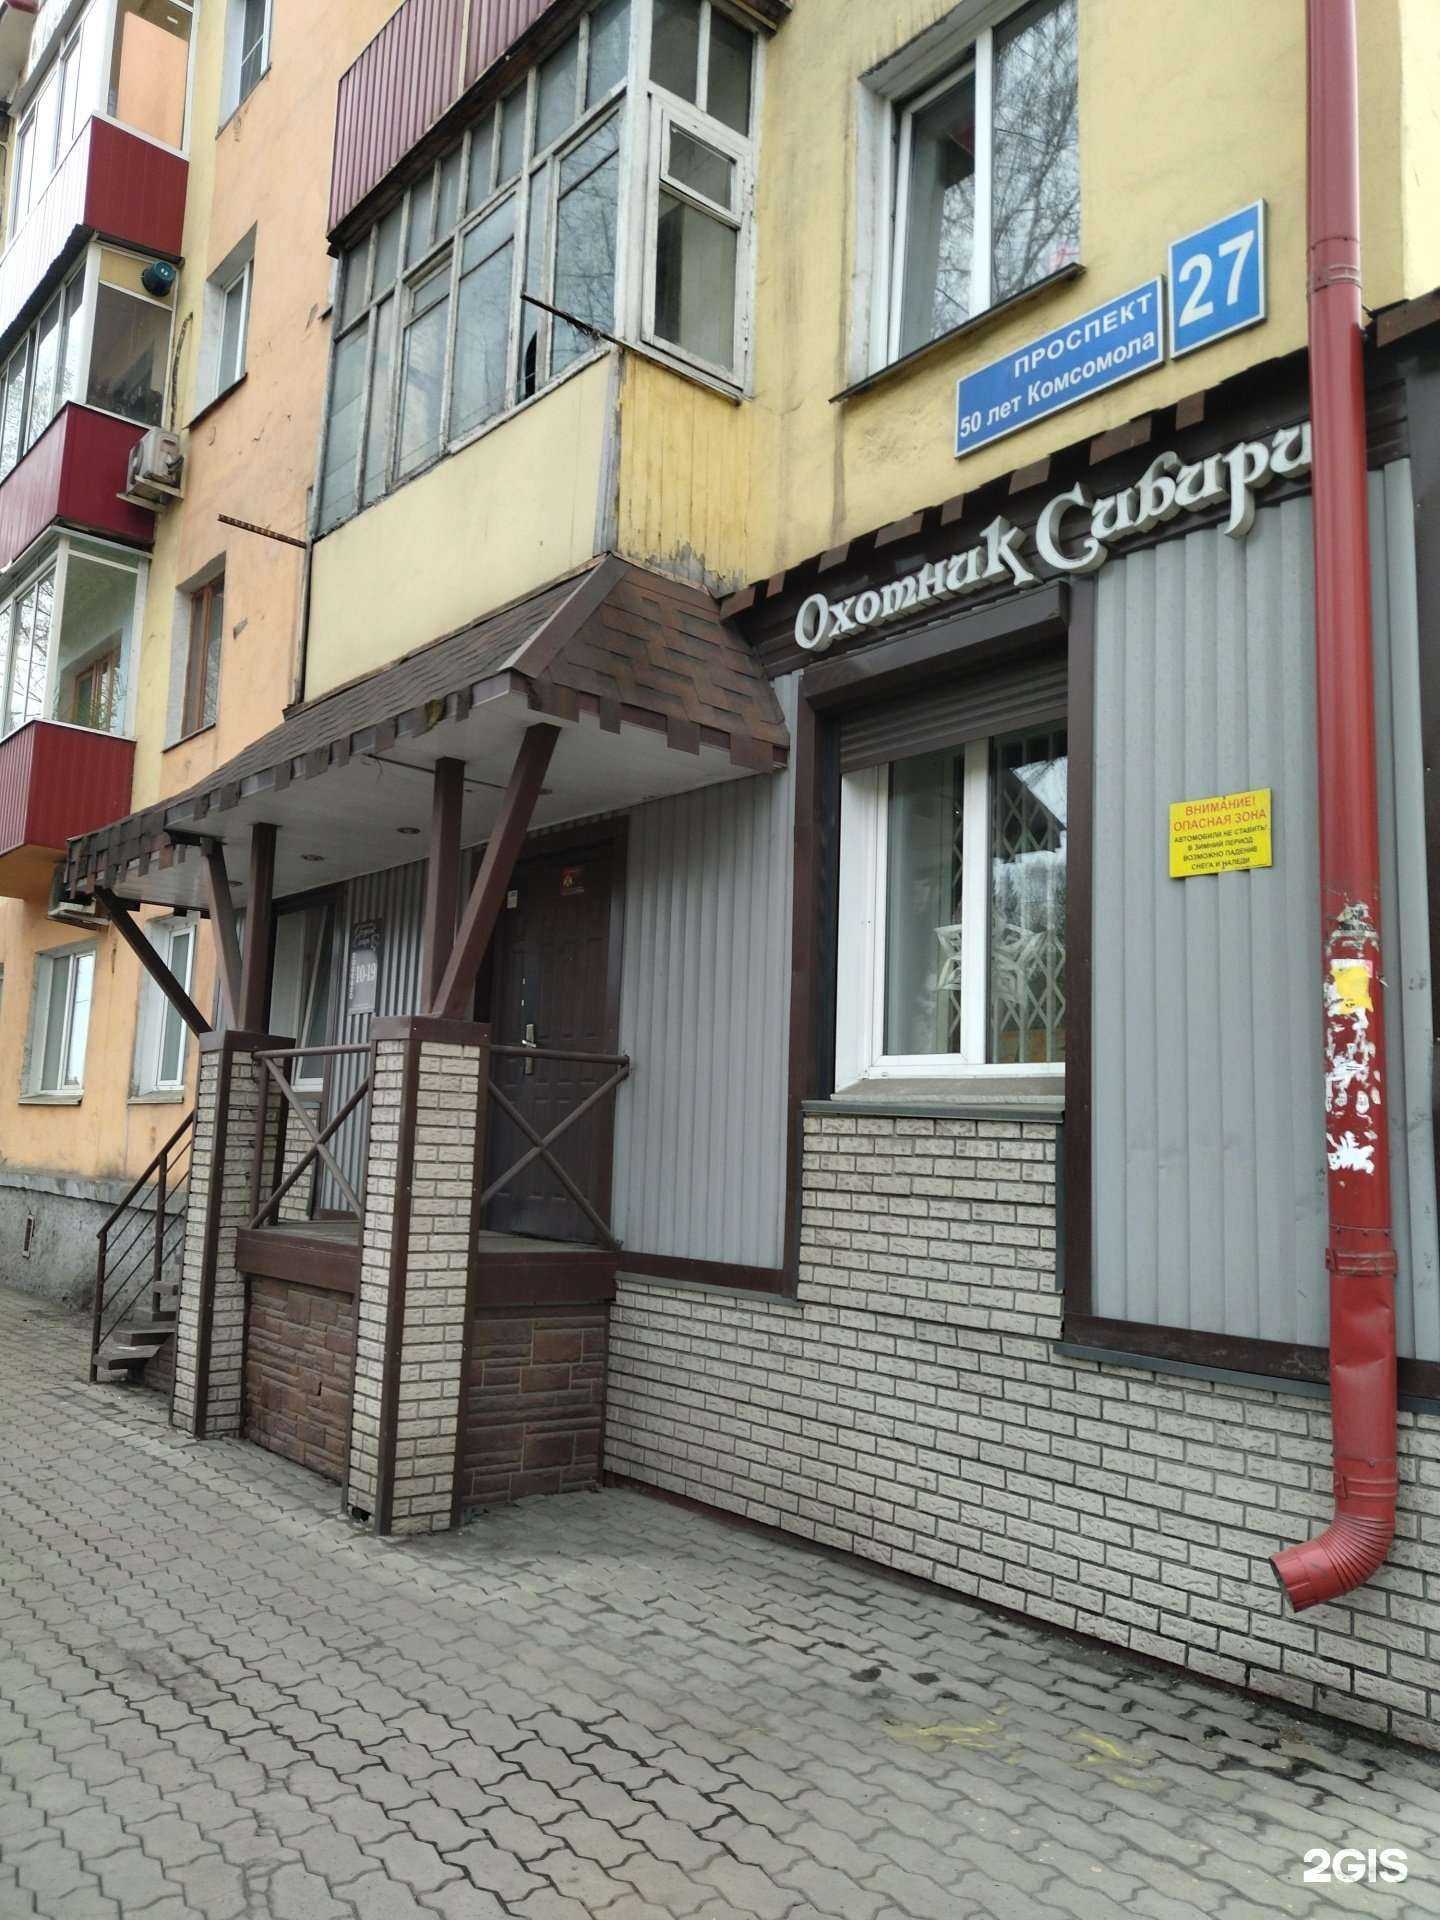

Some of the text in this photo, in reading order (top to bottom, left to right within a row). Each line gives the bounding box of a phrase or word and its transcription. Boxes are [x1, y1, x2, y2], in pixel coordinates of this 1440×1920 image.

[1176, 229, 1256, 328] 27
[1012, 292, 1153, 380] ПРОСПЕКТ
[959, 329, 1156, 438] 50 лет Комсомола
[794, 515, 1038, 653] Охотник
[1185, 796, 1256, 816] ВНИМАНИЕ!
[1174, 809, 1267, 831] ОПАСНАЯ ЗОНА
[1175, 831, 1222, 843] АВТОМОБИЛИ
[1223, 828, 1233, 837] НЕ
[1194, 840, 1224, 851] ЗИМНИЙ
[1224, 836, 1254, 847] ПЕРИОД
[1183, 845, 1258, 862] ВОЗМОЖНО ПАДЕНИЕ
[1191, 861, 1215, 871] СНЕГА
[1223, 857, 1250, 867] НАЛЕДИ
[355, 962, 377, 984] 10-19
